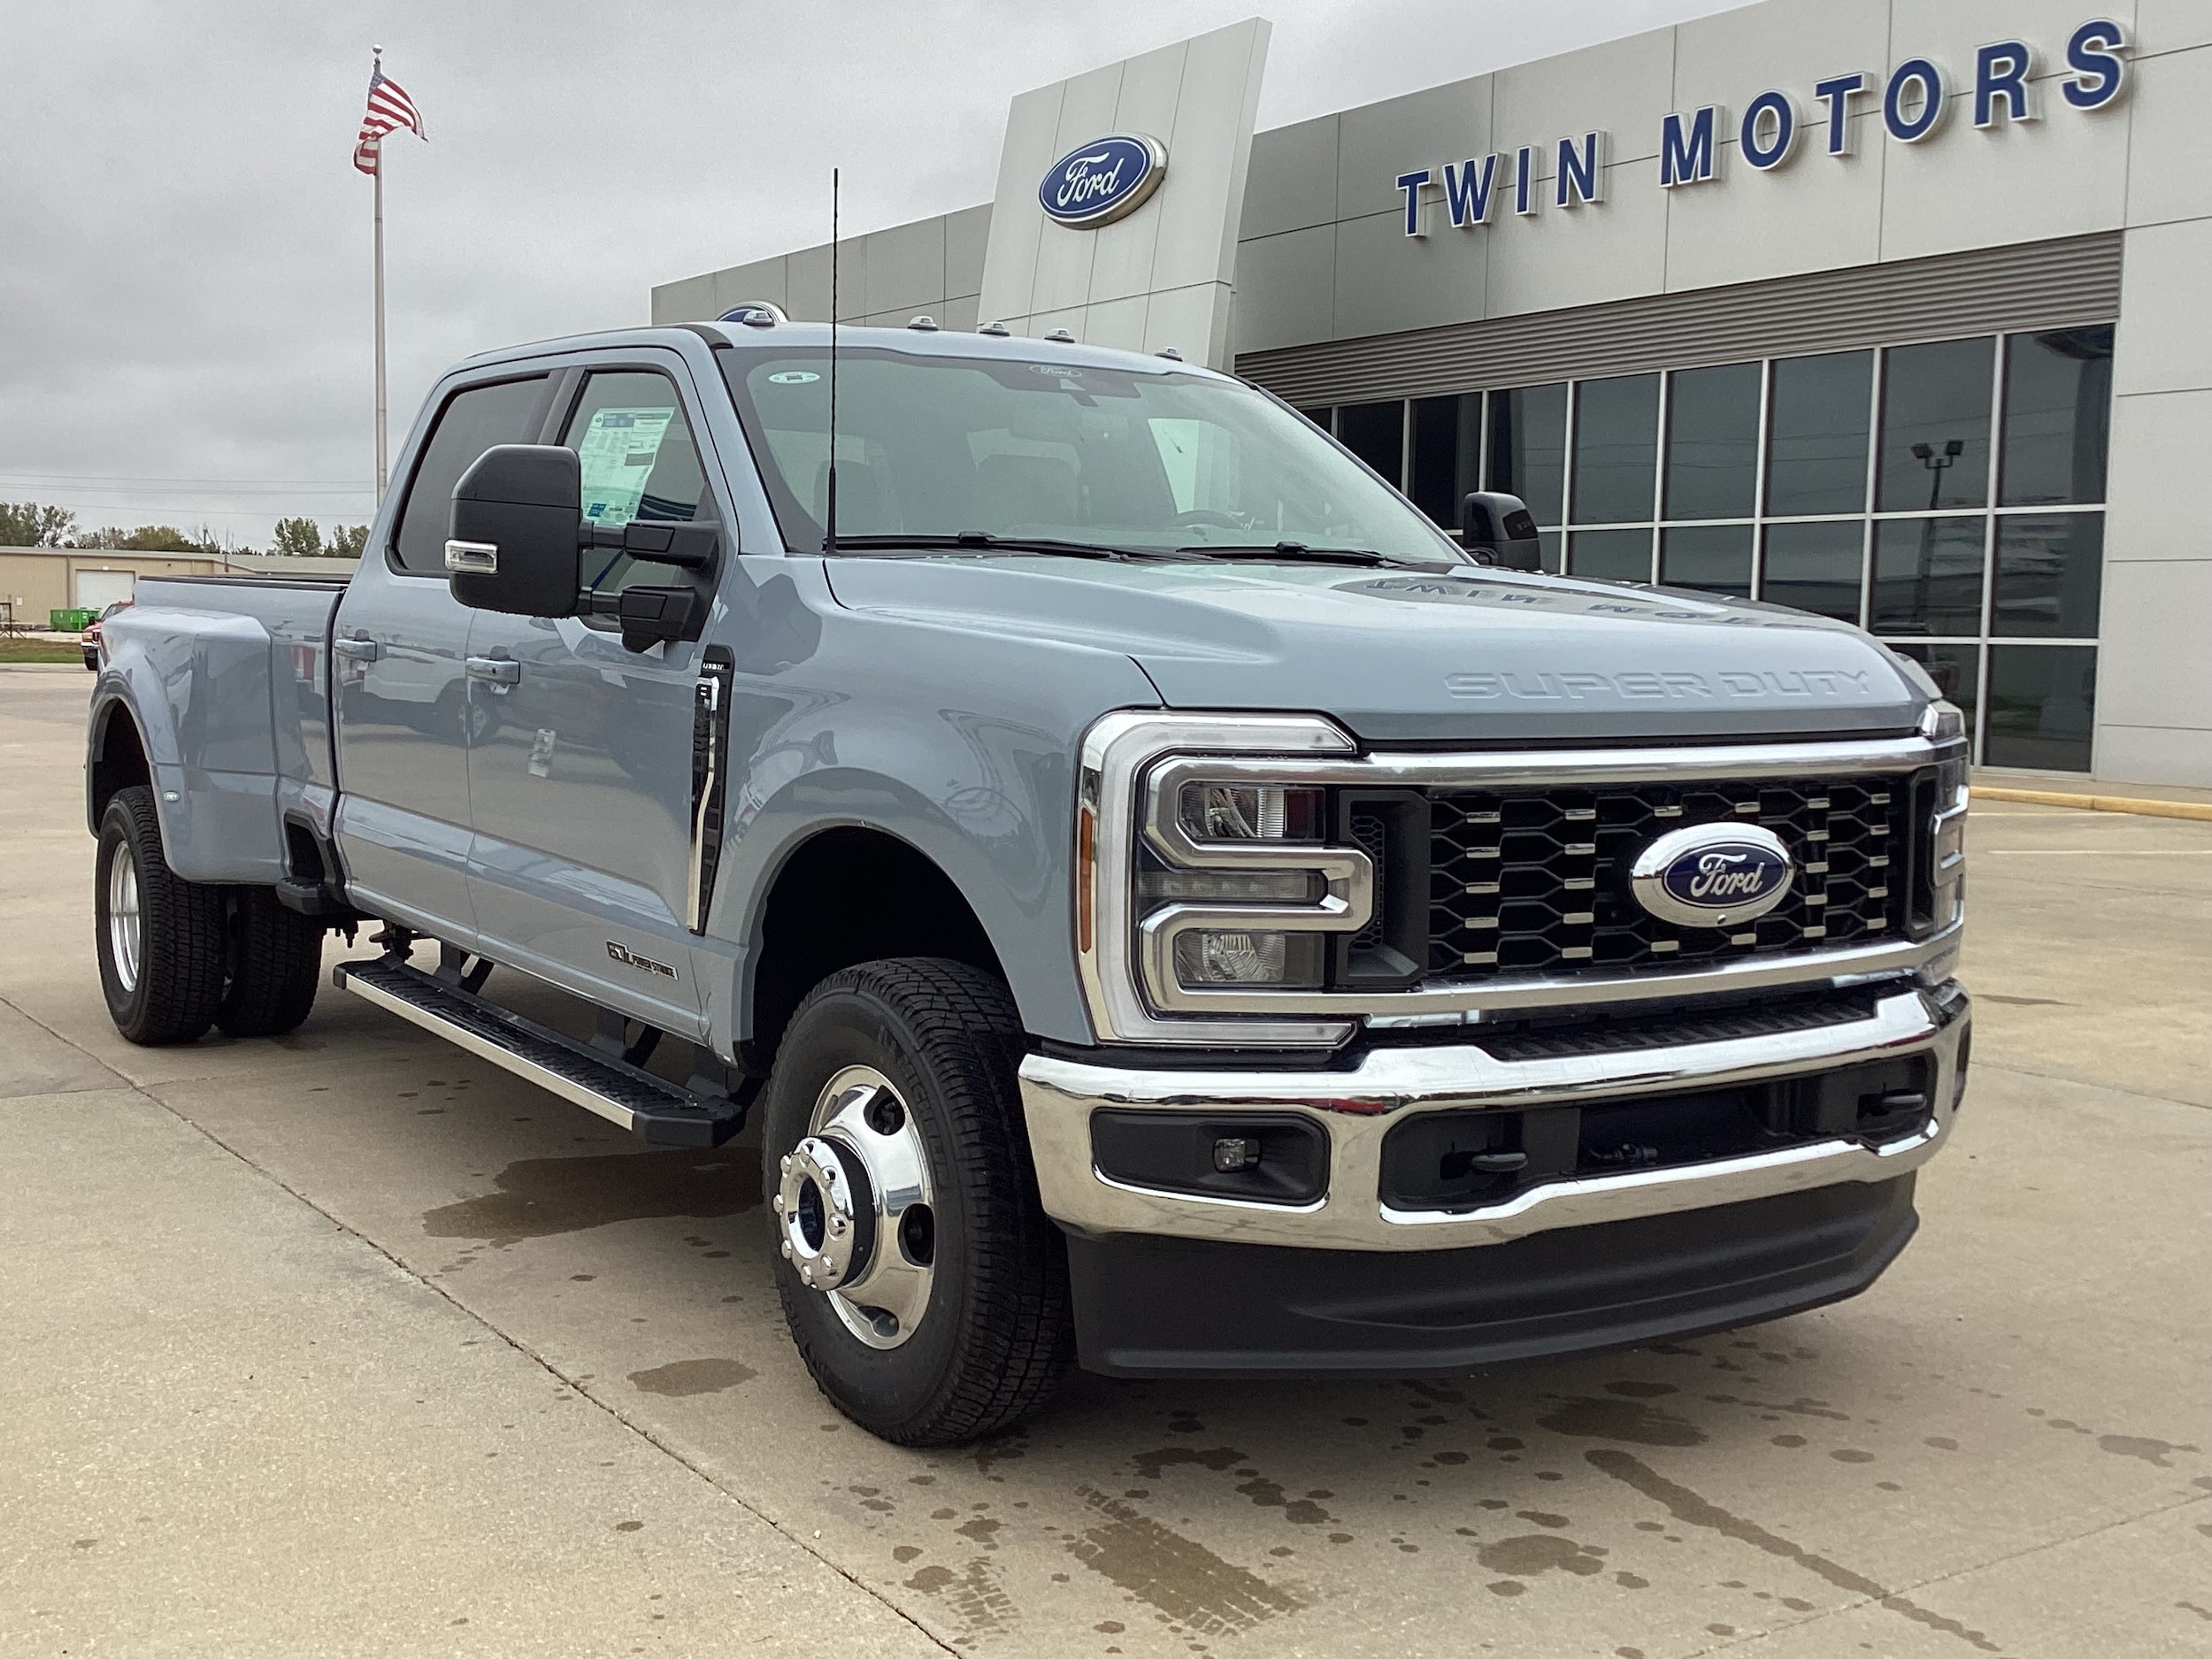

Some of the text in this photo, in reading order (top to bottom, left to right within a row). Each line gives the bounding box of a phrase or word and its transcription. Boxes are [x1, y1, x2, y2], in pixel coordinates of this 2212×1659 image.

[1395, 18, 2129, 237] TWIN MOTORS
[1056, 151, 1125, 207] Ford
[1444, 670, 1871, 700] SUPER DUTY
[1690, 852, 1765, 897] Ford
